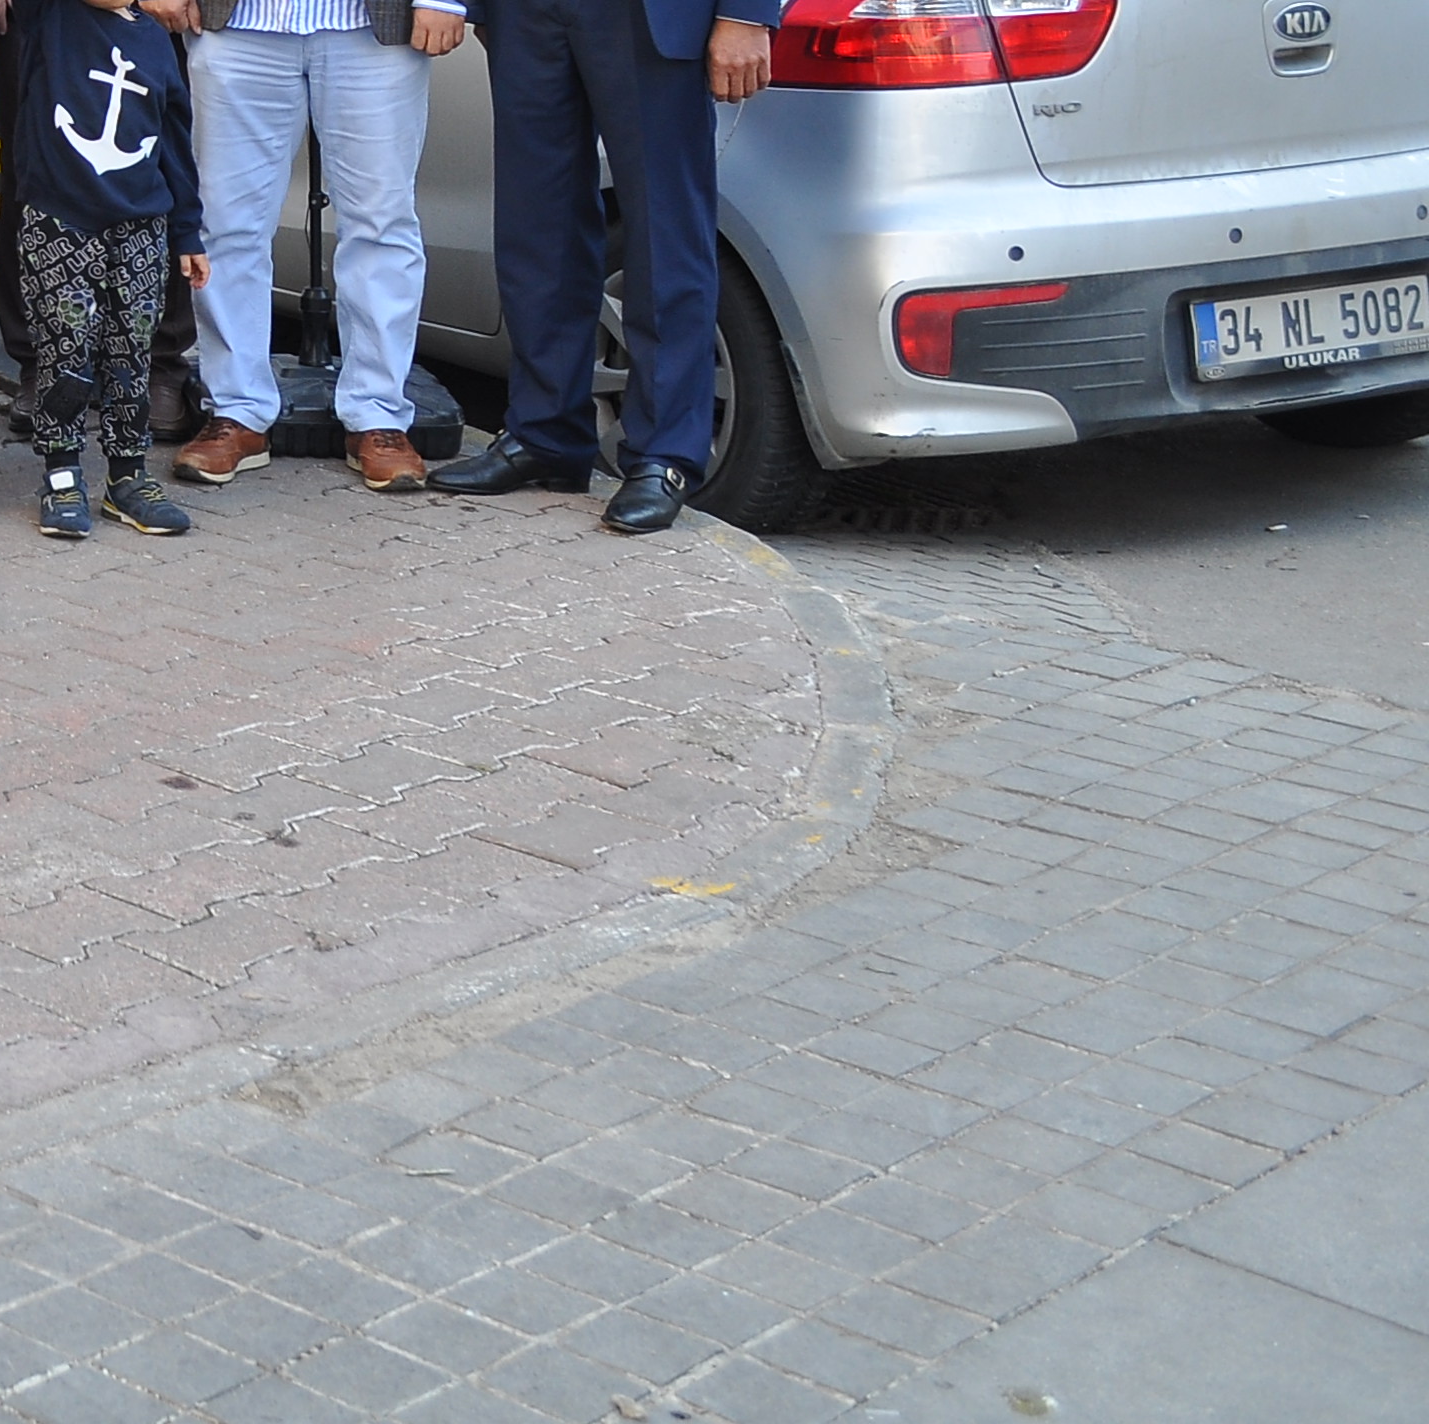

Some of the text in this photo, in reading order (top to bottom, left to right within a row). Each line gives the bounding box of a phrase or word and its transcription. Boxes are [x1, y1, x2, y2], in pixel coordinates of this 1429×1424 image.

[1286, 13, 1326, 35] KIA
[1033, 102, 1082, 118] RIO
[1219, 284, 1424, 356] 34 NL 5082
[1201, 339, 1217, 354] TR
[1284, 347, 1361, 369] ULUKAR
